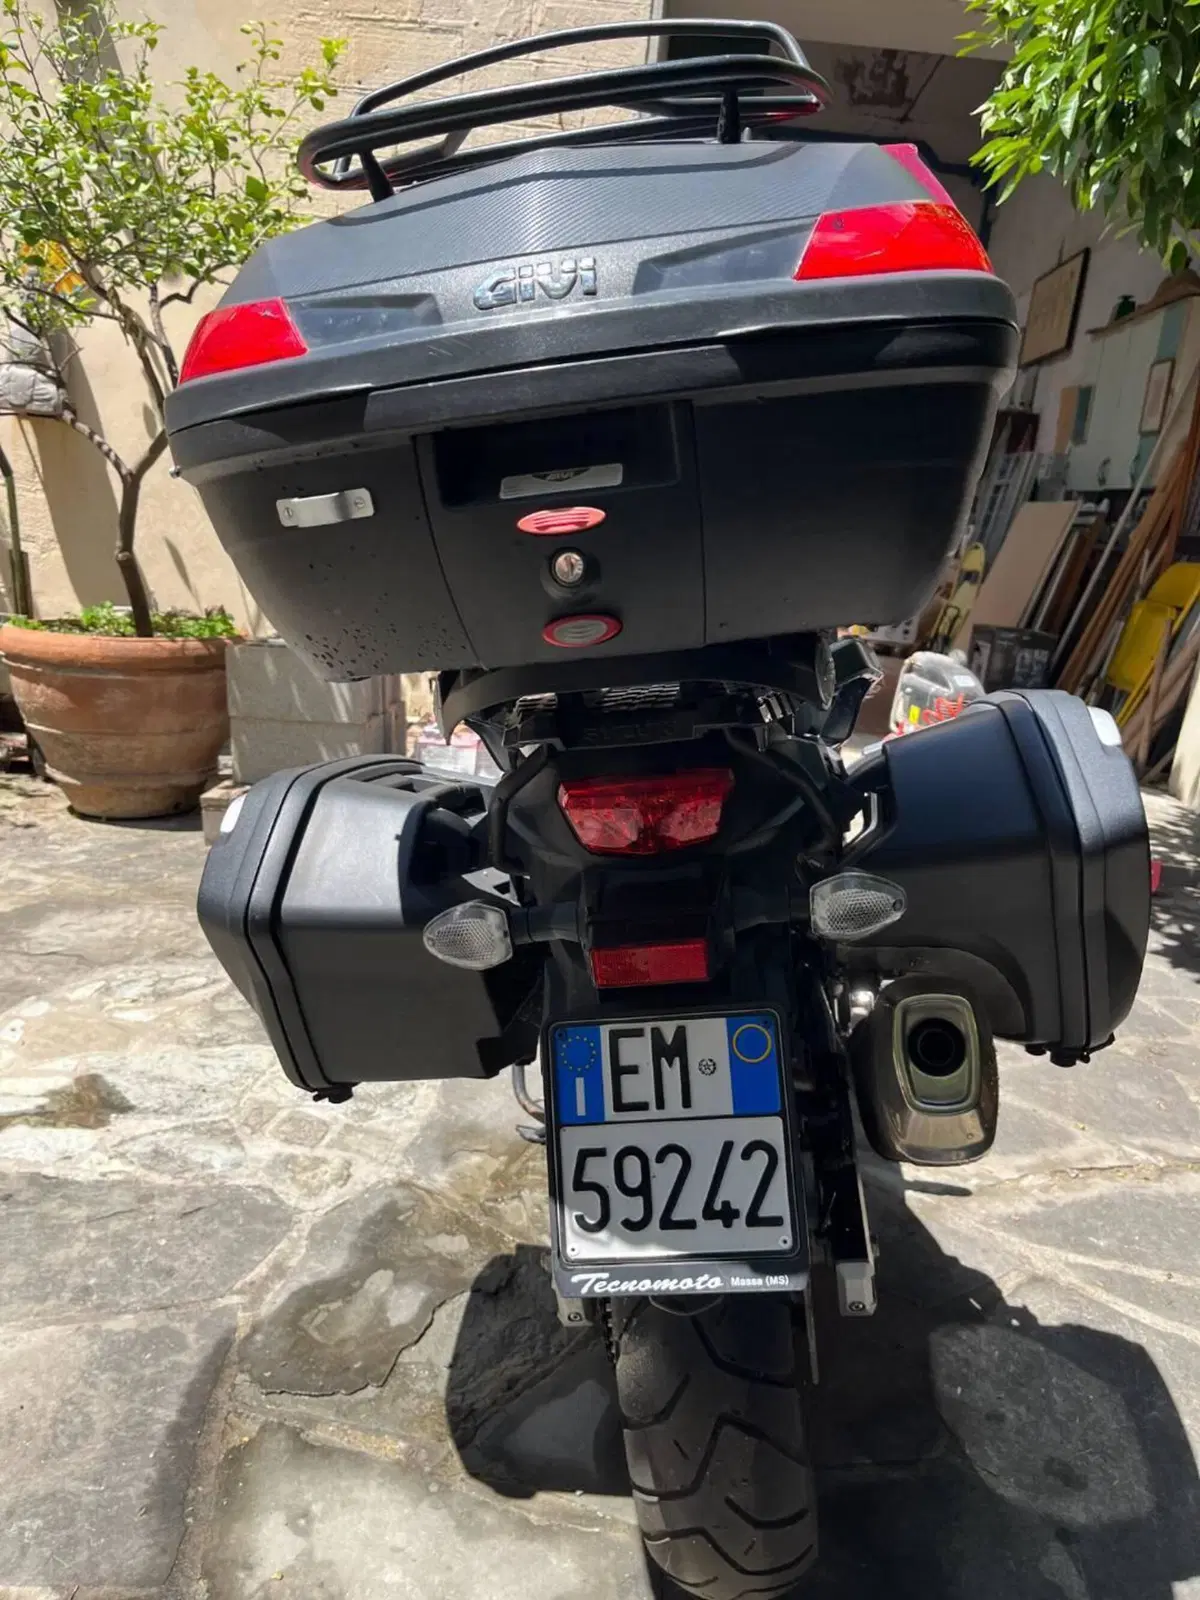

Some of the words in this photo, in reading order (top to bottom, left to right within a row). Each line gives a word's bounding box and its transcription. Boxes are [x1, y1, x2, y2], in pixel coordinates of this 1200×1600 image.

[473, 257, 597, 310] GIVI
[609, 1025, 692, 1113] EM
[572, 1139, 784, 1233] 59242
[571, 1272, 723, 1294] Tecnomoto
[731, 1276, 763, 1286] Massa
[765, 1275, 789, 1286] (MS)
